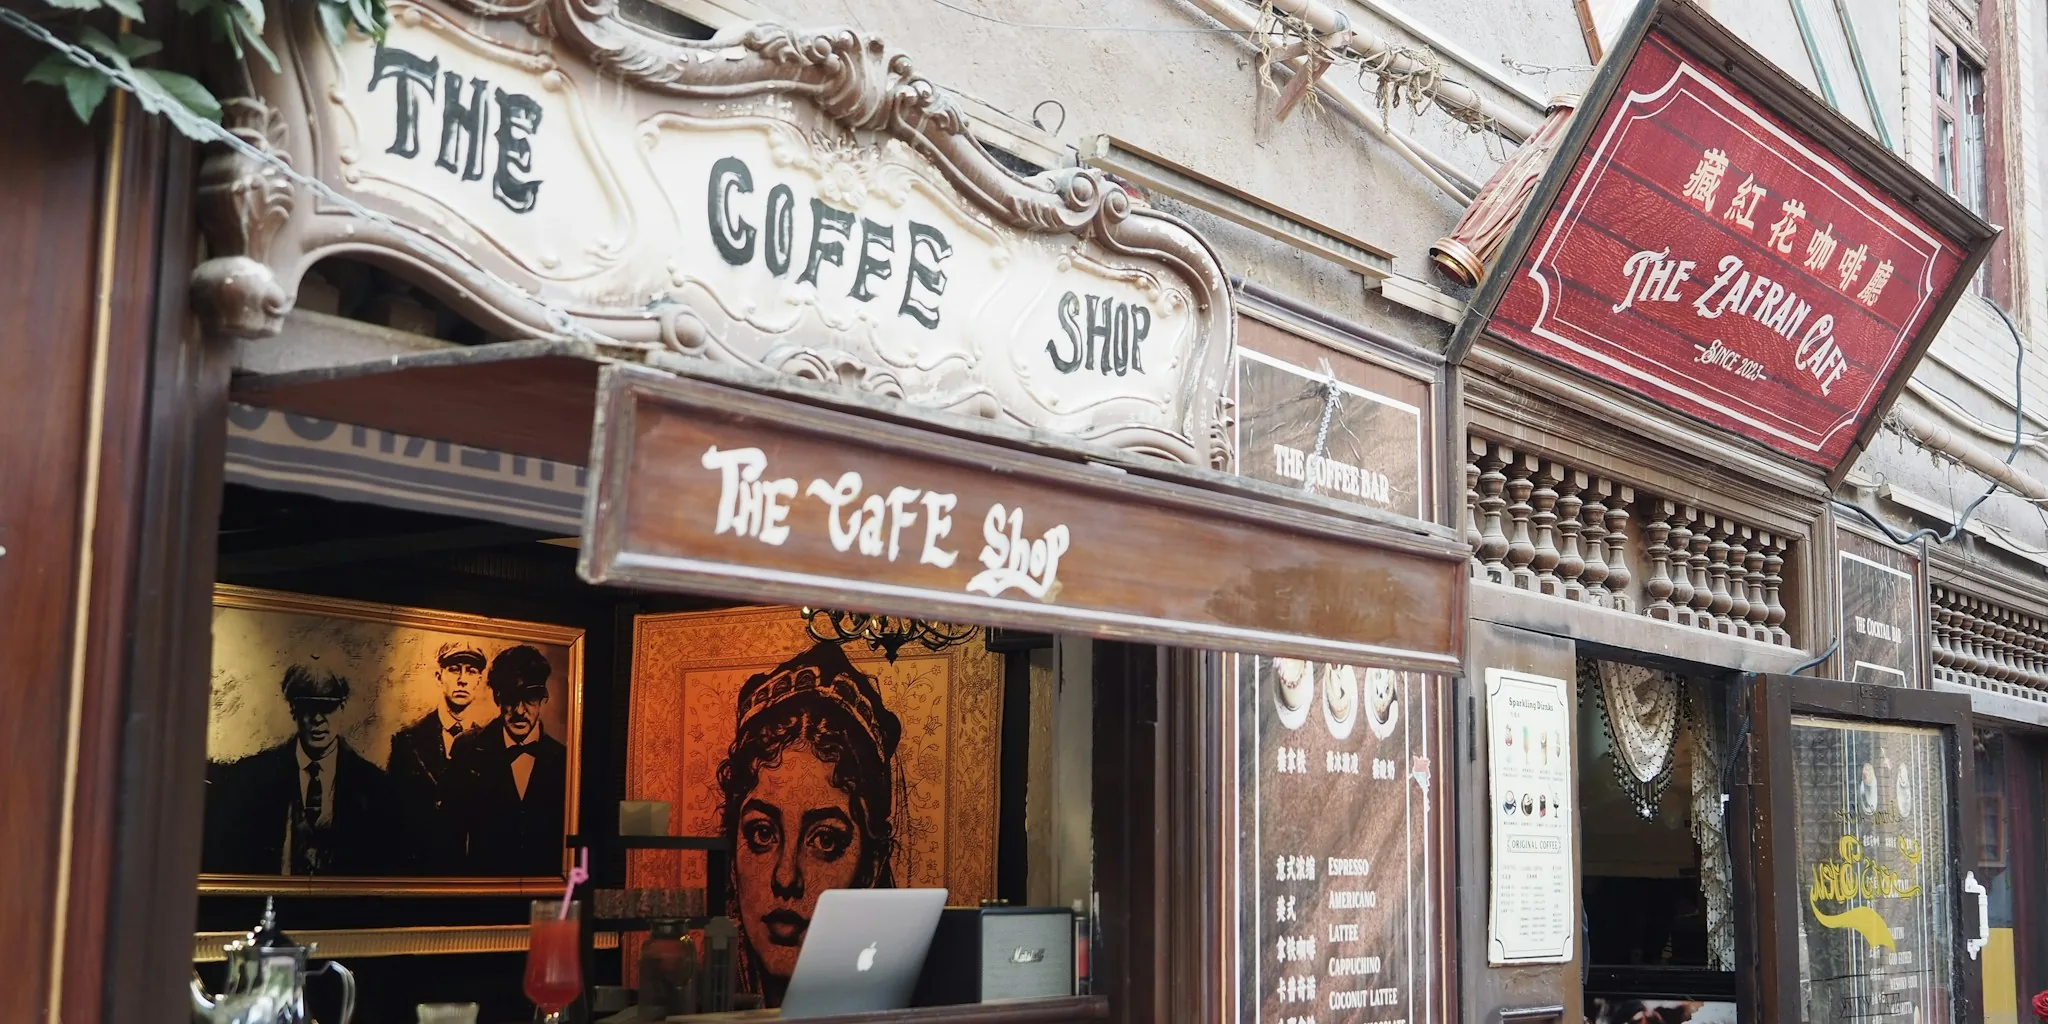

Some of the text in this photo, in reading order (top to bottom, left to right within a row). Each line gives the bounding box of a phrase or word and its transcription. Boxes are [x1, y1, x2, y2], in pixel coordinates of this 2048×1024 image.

[368, 41, 1151, 377] THE COFFE SHOP
[1683, 148, 1894, 306] 藏紅花咖啡廳
[1612, 246, 1849, 397] THE ZAFRAN CAFE
[1273, 443, 1390, 503] THE COFFEE BAR
[701, 444, 799, 546] THE
[965, 503, 1071, 598] Shop
[1855, 616, 1902, 644] THE COCKTAIL BAR
[1508, 697, 1536, 712] Sparkling
[1511, 839, 1558, 850] ORIGINAL COFFEE
[1276, 854, 1316, 881] 意式浓缩
[1328, 856, 1369, 876] ESPRESSO
[1276, 894, 1297, 922] 美式
[1328, 890, 1377, 909] AMERICANO
[1328, 923, 1359, 942] LATTEE
[1276, 934, 1316, 963] 拿铁咖啡
[1328, 956, 1381, 977] CAPPUCHINO
[1328, 987, 1398, 1010] COCONUT LATTEE
